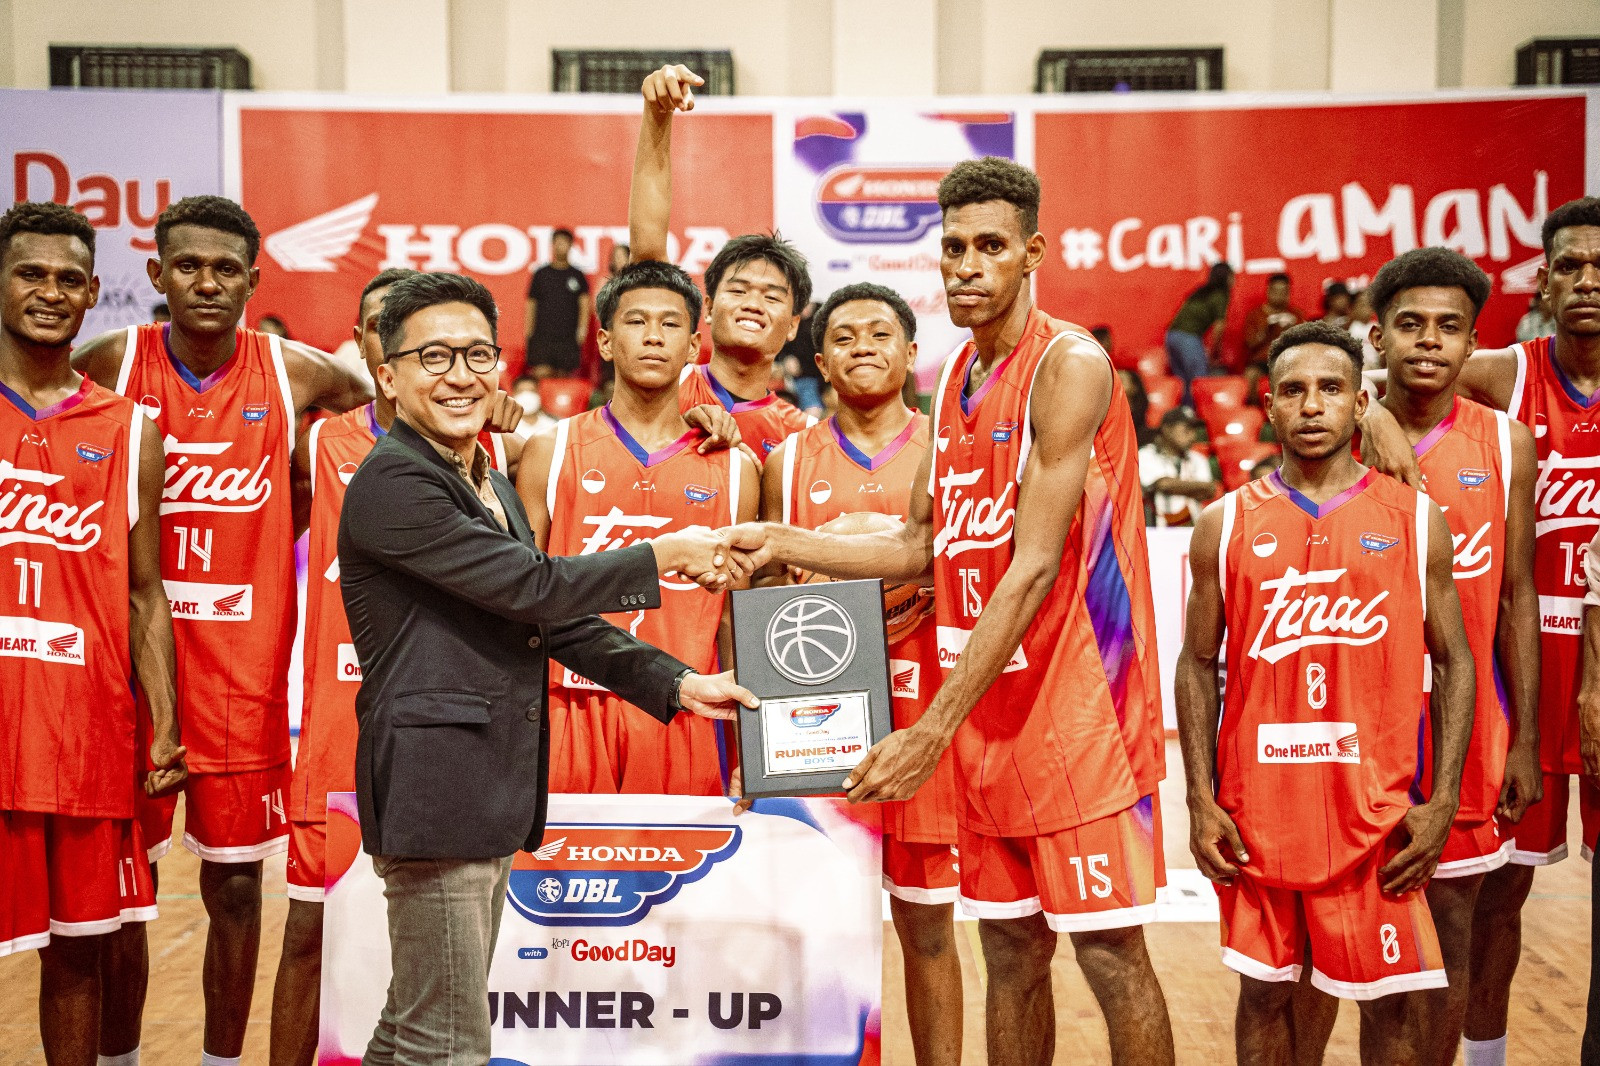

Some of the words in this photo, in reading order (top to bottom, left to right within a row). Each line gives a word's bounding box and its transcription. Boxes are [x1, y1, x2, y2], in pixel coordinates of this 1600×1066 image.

[13, 151, 172, 252] Day
[933, 465, 1015, 560] Final
[1535, 449, 1600, 538] Fin
[173, 526, 213, 572] 14
[1559, 541, 1589, 587] 13
[13, 557, 43, 608] 11
[958, 568, 983, 618] 15
[168, 599, 200, 615] ART.
[1247, 565, 1390, 665] Final
[1543, 615, 1581, 630] HEART.
[46, 650, 82, 659] HONDA
[344, 662, 362, 676] On
[1305, 662, 1328, 709] 8
[775, 744, 862, 759] RUNNER-UP
[804, 757, 835, 765] BOYS
[1264, 744, 1288, 758] One
[1290, 743, 1332, 758] HEART.
[261, 788, 287, 830] 14
[566, 846, 685, 862] HONDA
[118, 857, 138, 898] 11
[563, 878, 622, 903] DBL
[1069, 853, 1113, 900] 15
[524, 949, 542, 957] with
[1379, 923, 1401, 965] 8
[487, 991, 655, 1029] NNER
[708, 991, 783, 1029] UP
